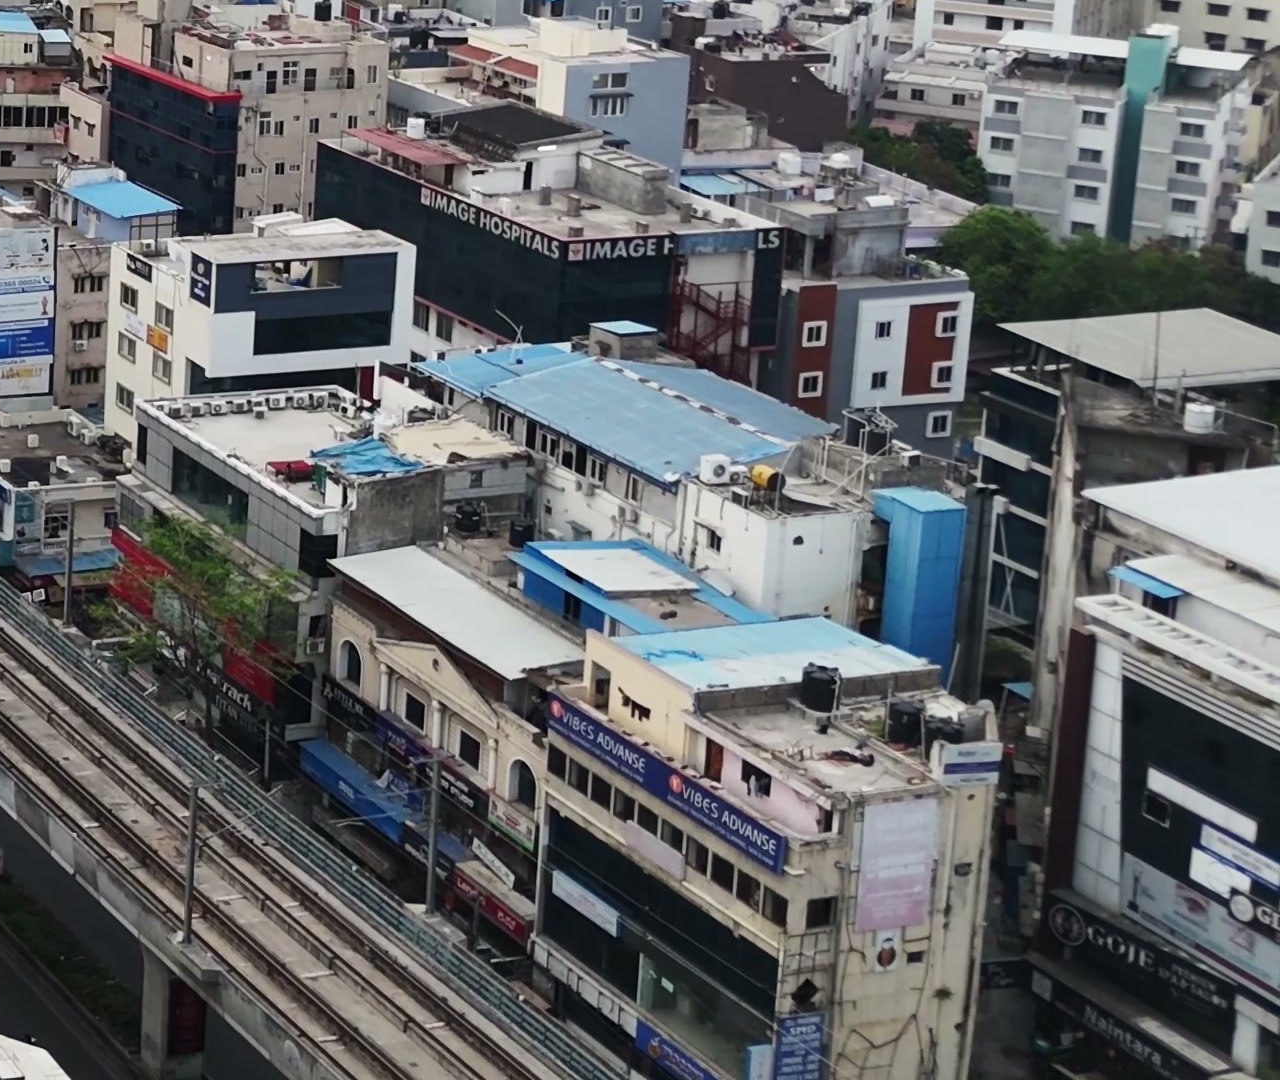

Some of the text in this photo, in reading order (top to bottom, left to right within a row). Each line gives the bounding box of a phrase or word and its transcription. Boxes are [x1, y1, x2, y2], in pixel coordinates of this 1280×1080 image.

[430, 192, 560, 259] IMAGE HOSPITALS
[585, 239, 656, 260] IMAGE
[561, 710, 646, 773] VIBES ADVANSE
[682, 784, 777, 856] VIBES ADVANSE
[1087, 924, 1155, 969] GOJE
[789, 1025, 816, 1036] SMD
[1084, 1005, 1162, 1066] Naintara
